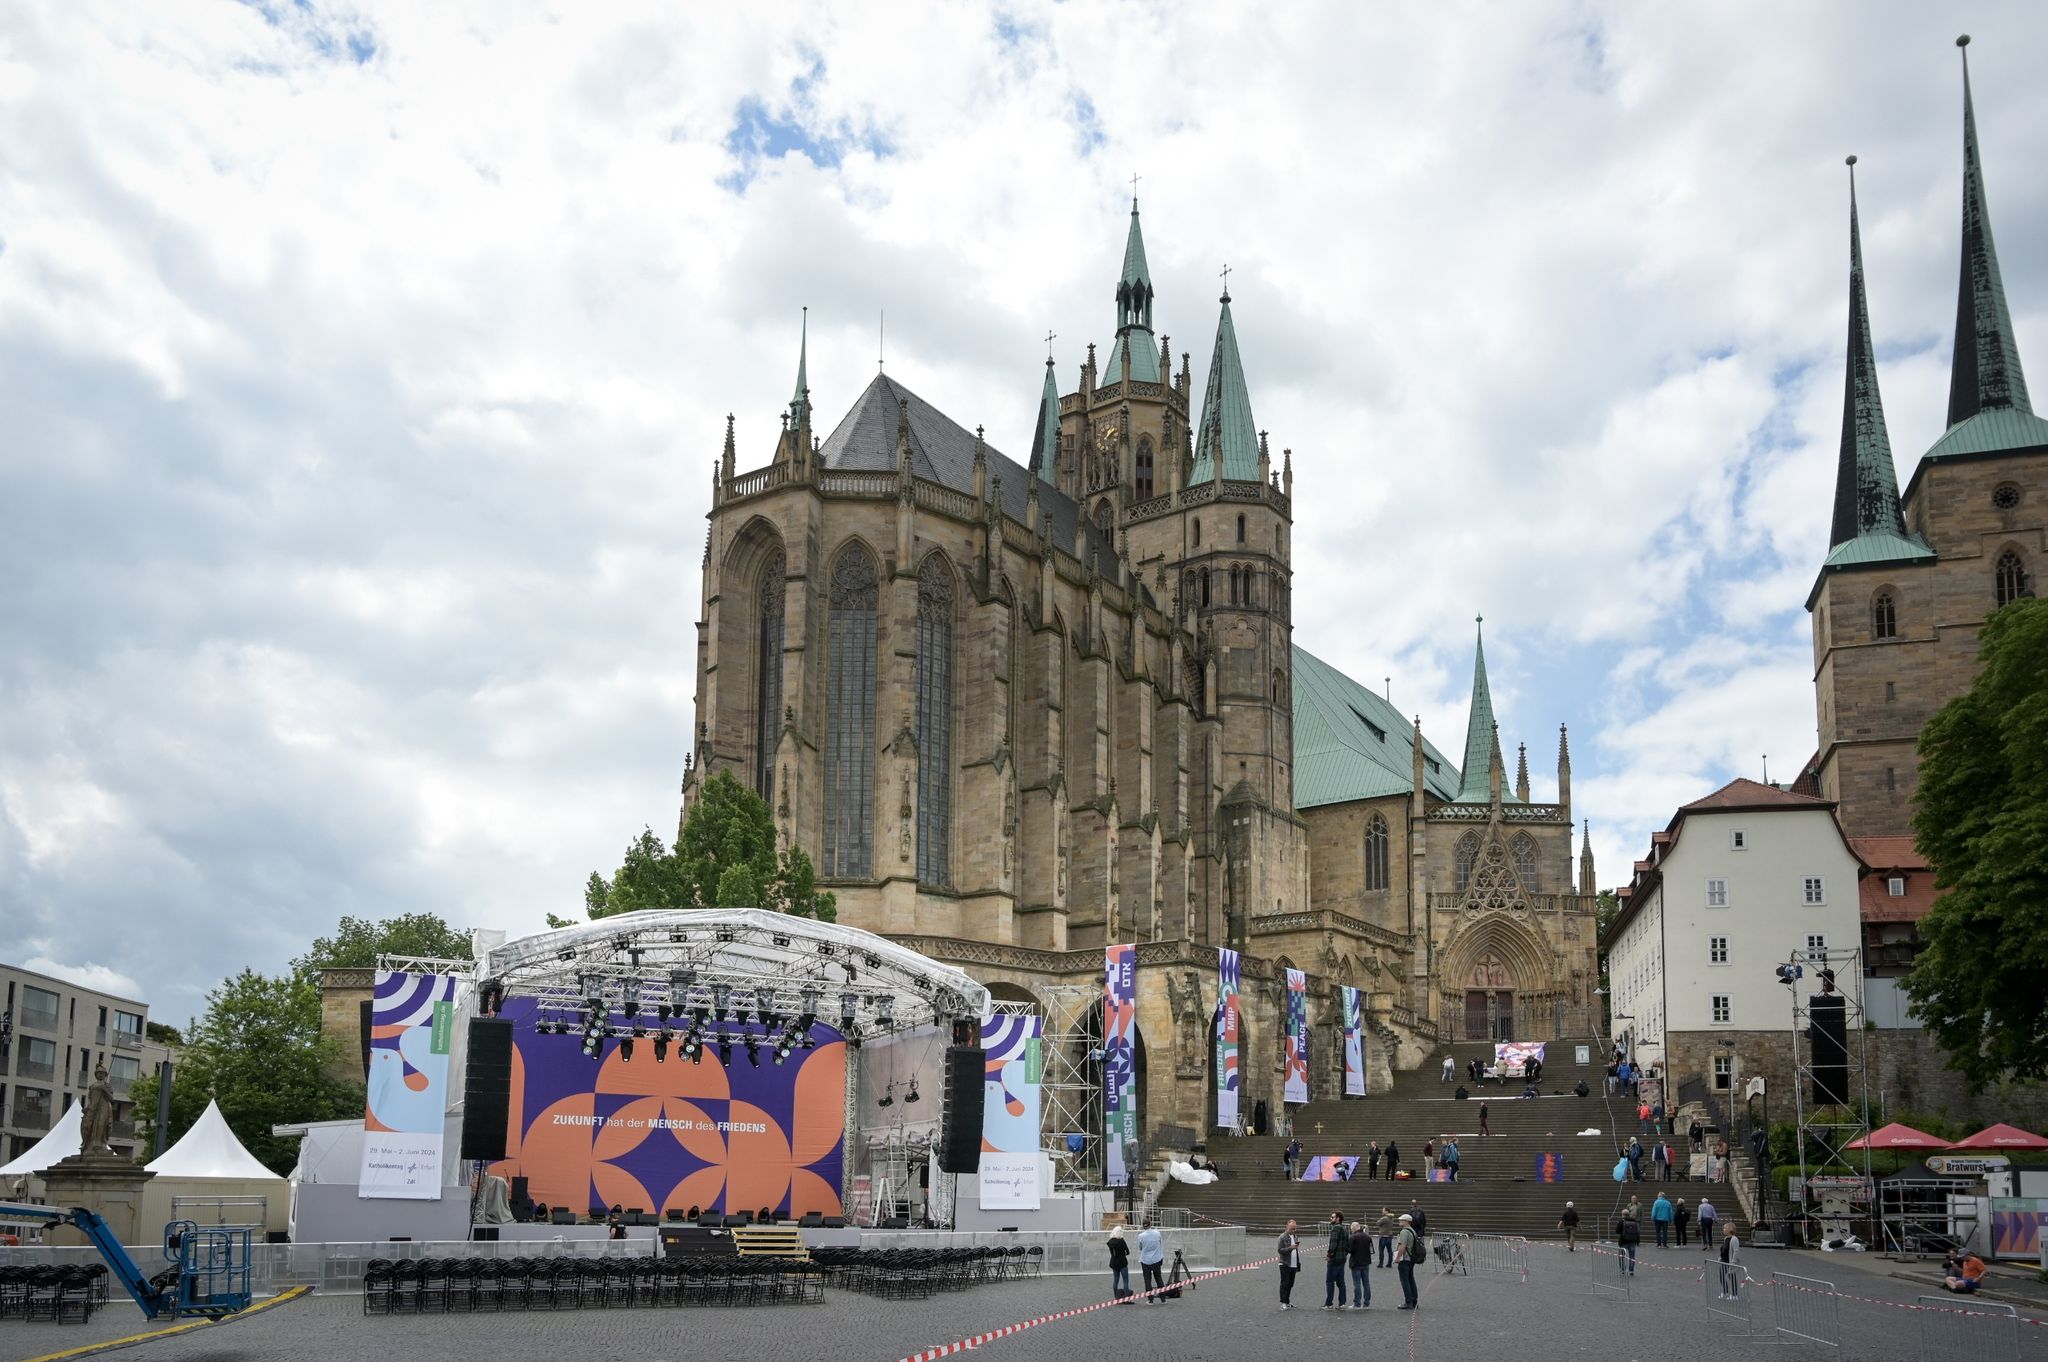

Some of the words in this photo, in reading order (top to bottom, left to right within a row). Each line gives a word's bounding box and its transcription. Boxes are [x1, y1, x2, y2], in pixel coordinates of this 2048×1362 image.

[1122, 963, 1131, 988] אדם
[1227, 1006, 1235, 1031] МИР
[1216, 1044, 1225, 1087] FRIEDEN
[553, 1114, 604, 1127] ZUKUNFT
[606, 1117, 624, 1128] hat
[627, 1117, 645, 1128] der
[647, 1118, 693, 1130] MENSCH
[695, 1121, 715, 1131] des
[717, 1121, 766, 1133] FRIEDENS
[1124, 1113, 1134, 1145] NSCH
[381, 1147, 393, 1155] Mai
[368, 1163, 403, 1171] Katholikentag
[1946, 1162, 1986, 1172] Bratwurst
